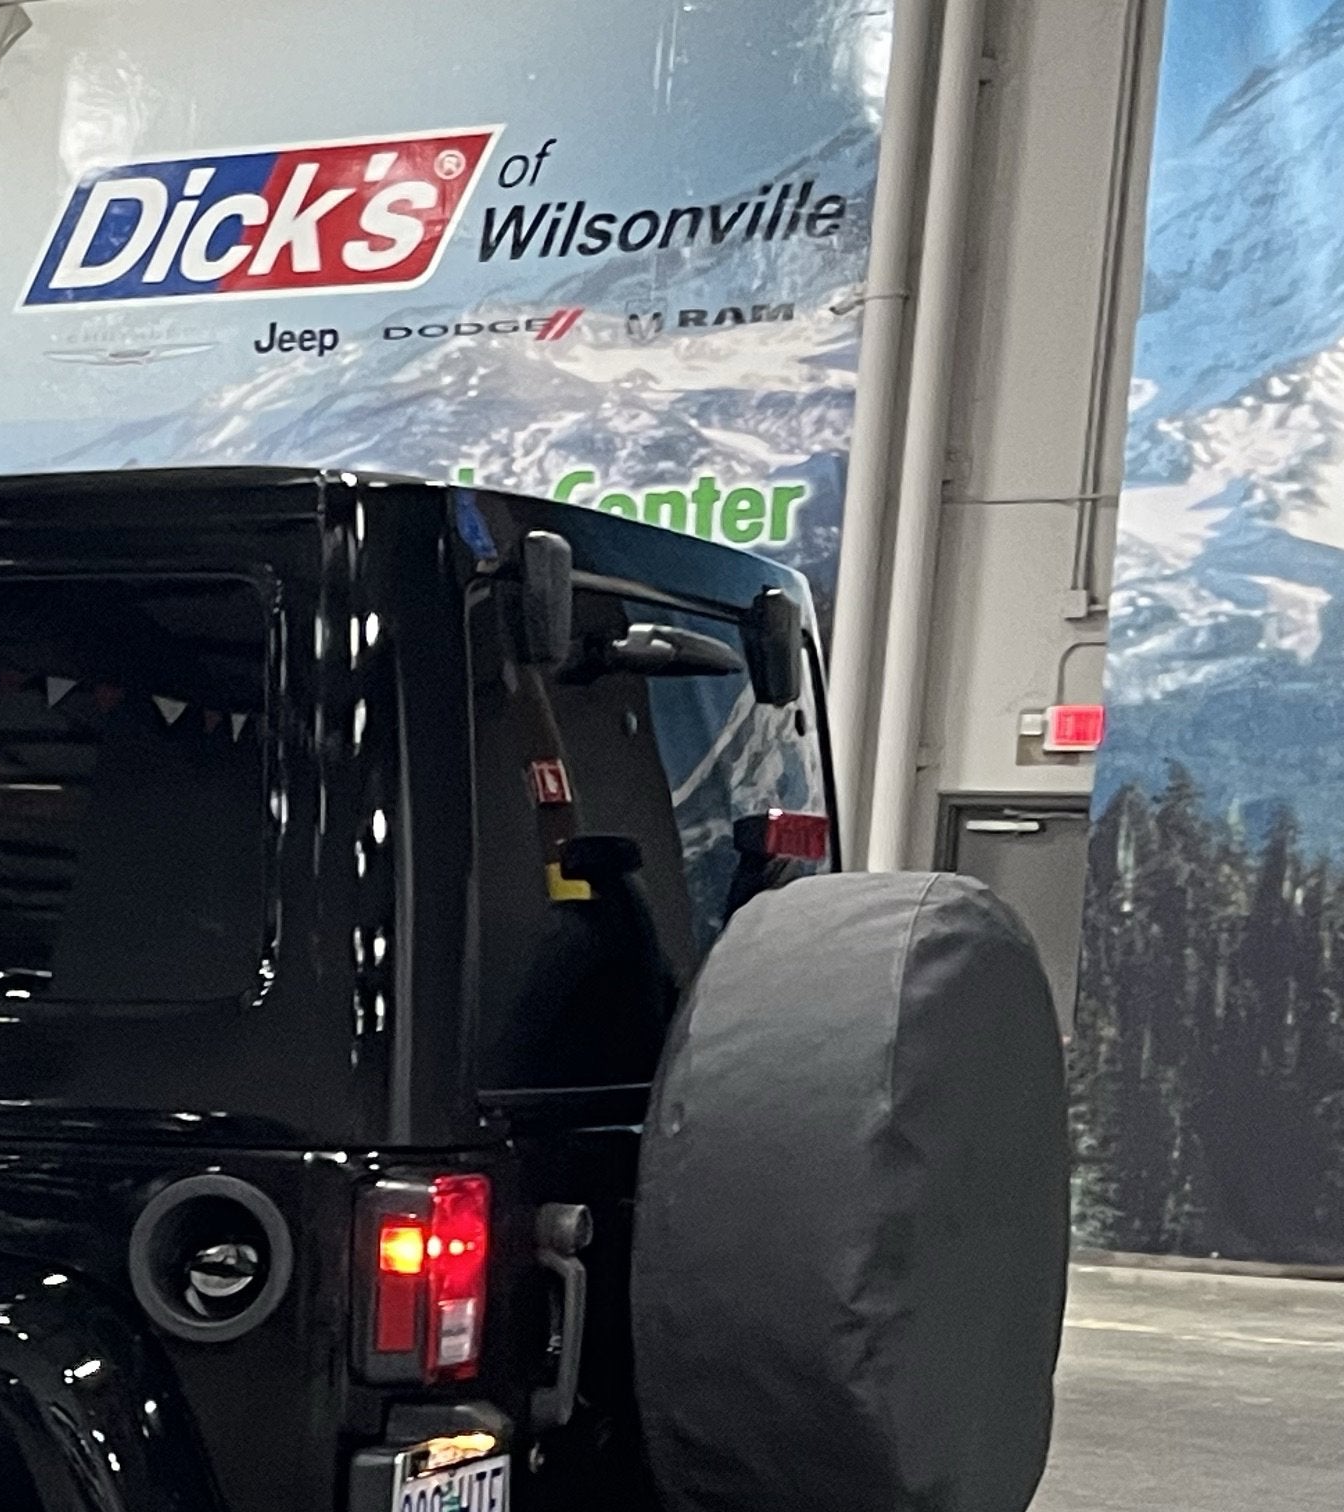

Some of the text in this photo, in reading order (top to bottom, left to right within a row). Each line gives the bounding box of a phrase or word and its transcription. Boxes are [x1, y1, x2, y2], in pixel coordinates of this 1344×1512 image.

[48, 138, 557, 290] Dick's of
[478, 180, 849, 263] Wilsonville
[383, 317, 549, 341] DODGE
[678, 301, 796, 328] RAM
[253, 321, 339, 357] Jeep
